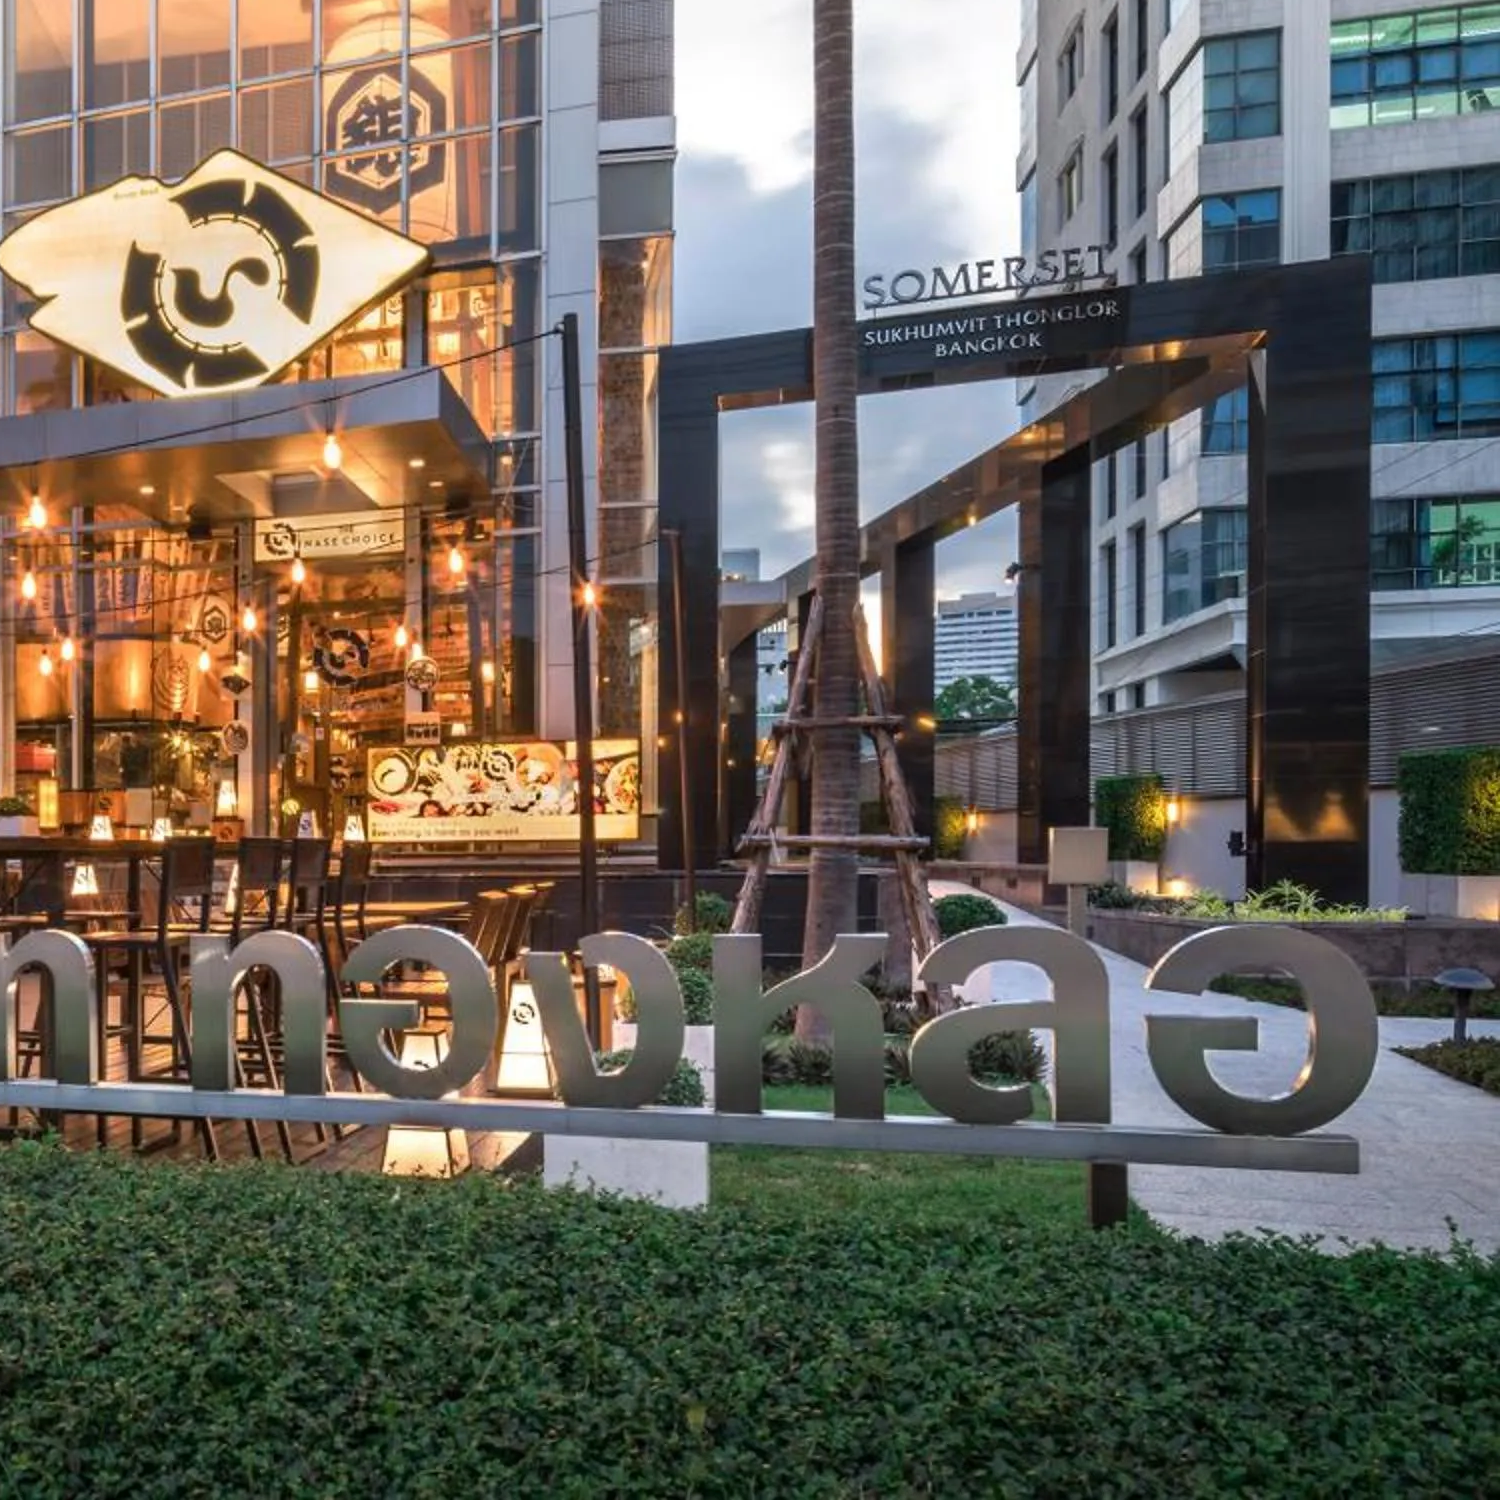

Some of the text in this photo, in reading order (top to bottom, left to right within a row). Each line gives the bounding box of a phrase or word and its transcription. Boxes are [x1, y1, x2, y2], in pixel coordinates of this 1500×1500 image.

[863, 244, 1120, 306] SOMERSET
[863, 299, 1121, 346] SUKHUMVIT THONGLOR
[935, 331, 1043, 358] BANGKOK
